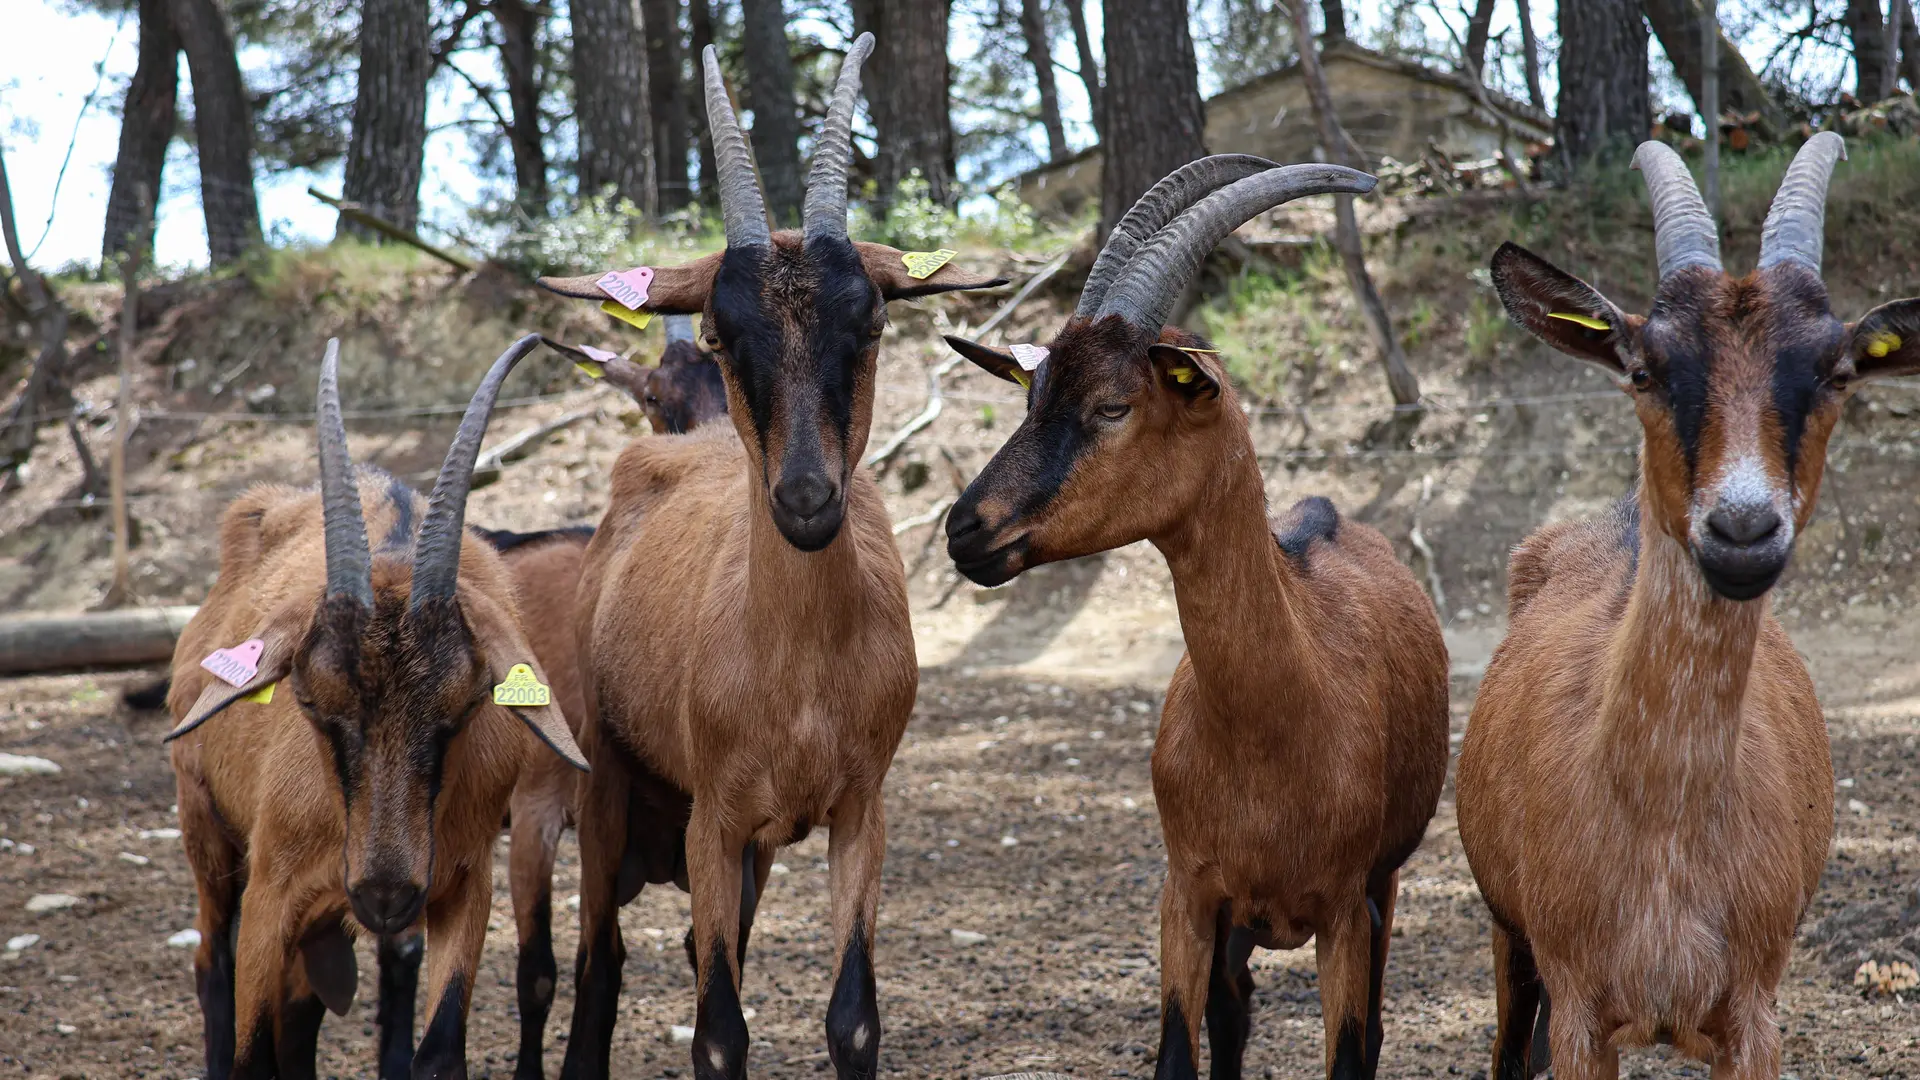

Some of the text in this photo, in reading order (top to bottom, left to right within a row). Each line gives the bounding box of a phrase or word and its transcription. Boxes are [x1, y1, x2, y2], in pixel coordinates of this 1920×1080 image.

[911, 249, 955, 277] 22001
[600, 274, 647, 308] 22001
[496, 687, 546, 703] 22003
